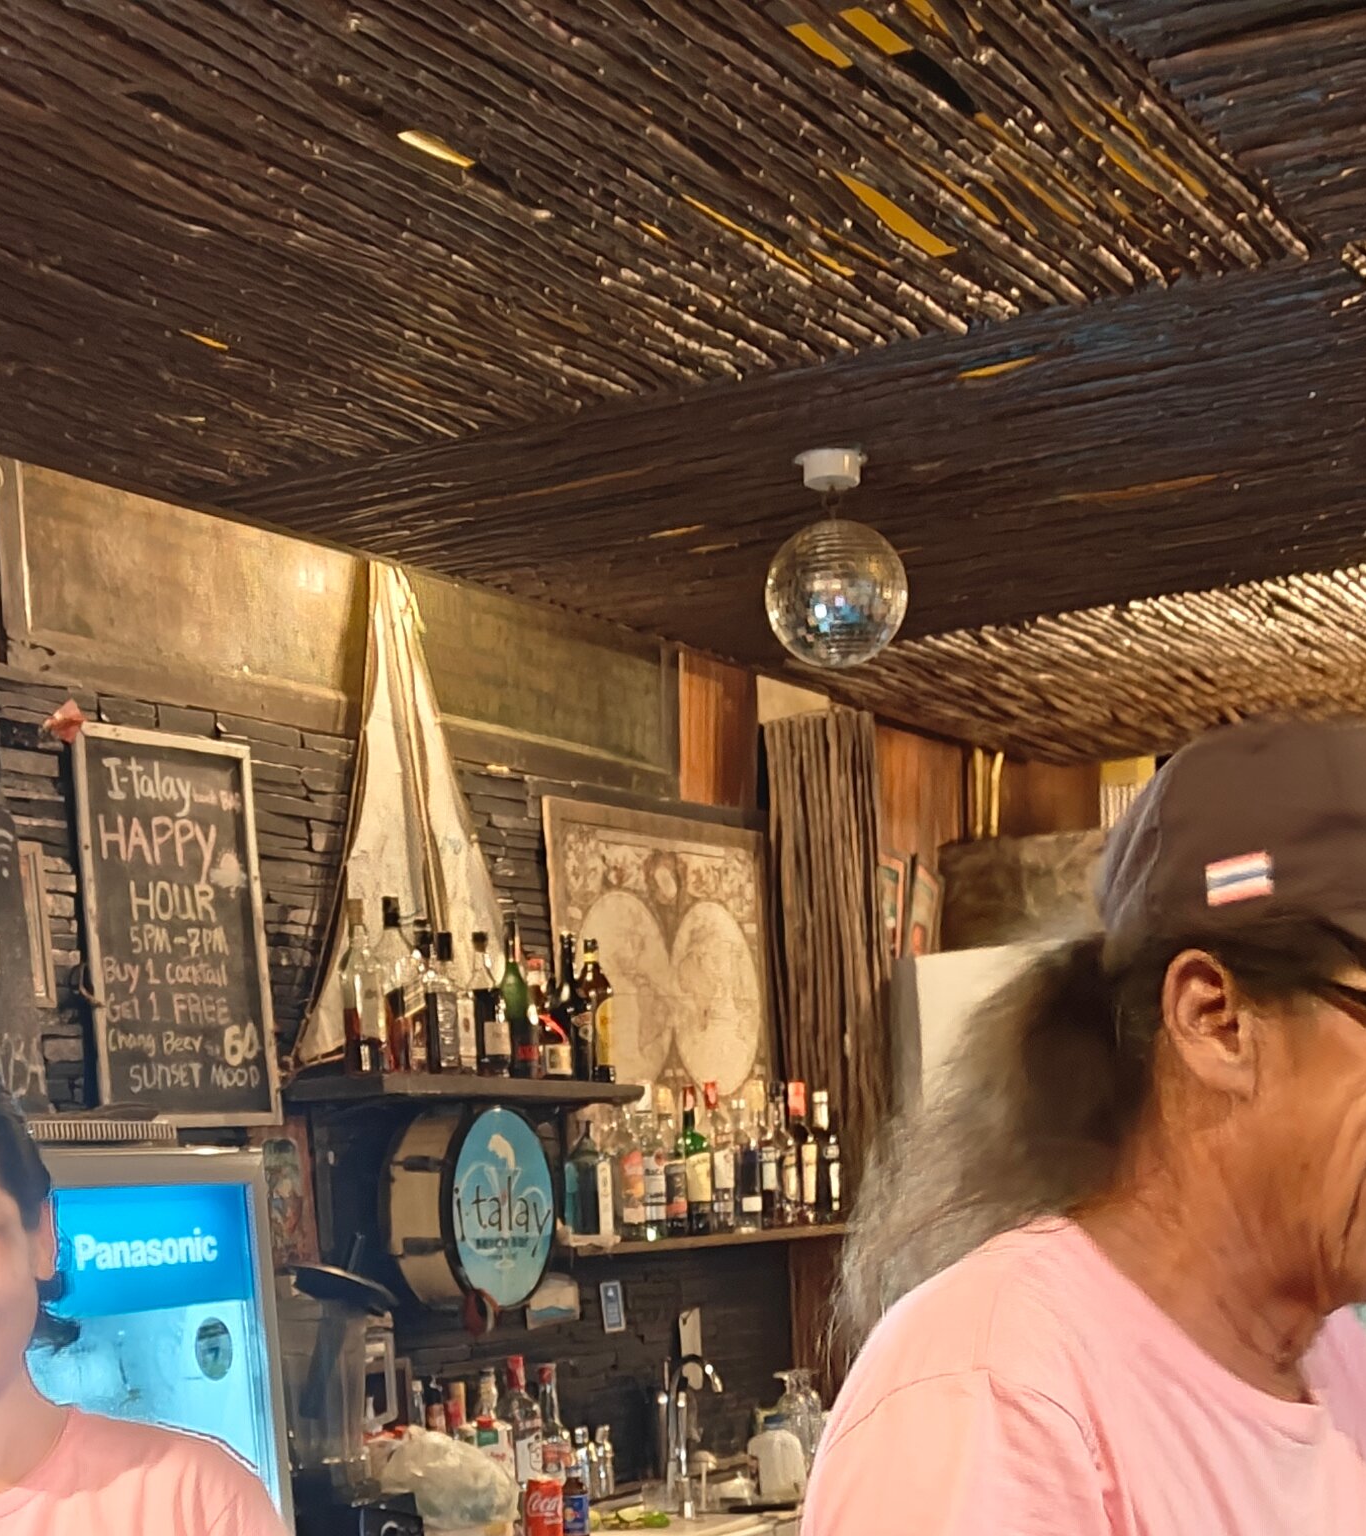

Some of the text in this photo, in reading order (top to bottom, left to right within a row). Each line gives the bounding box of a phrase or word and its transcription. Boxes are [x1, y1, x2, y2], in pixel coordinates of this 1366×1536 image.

[98, 812, 217, 887] HAPPY
[130, 880, 216, 922] HOUR
[103, 957, 140, 994] Buy
[146, 959, 161, 985] 1
[150, 992, 161, 1022] 1
[172, 993, 231, 1025] FREE
[73, 1227, 217, 1272] Panasonic
